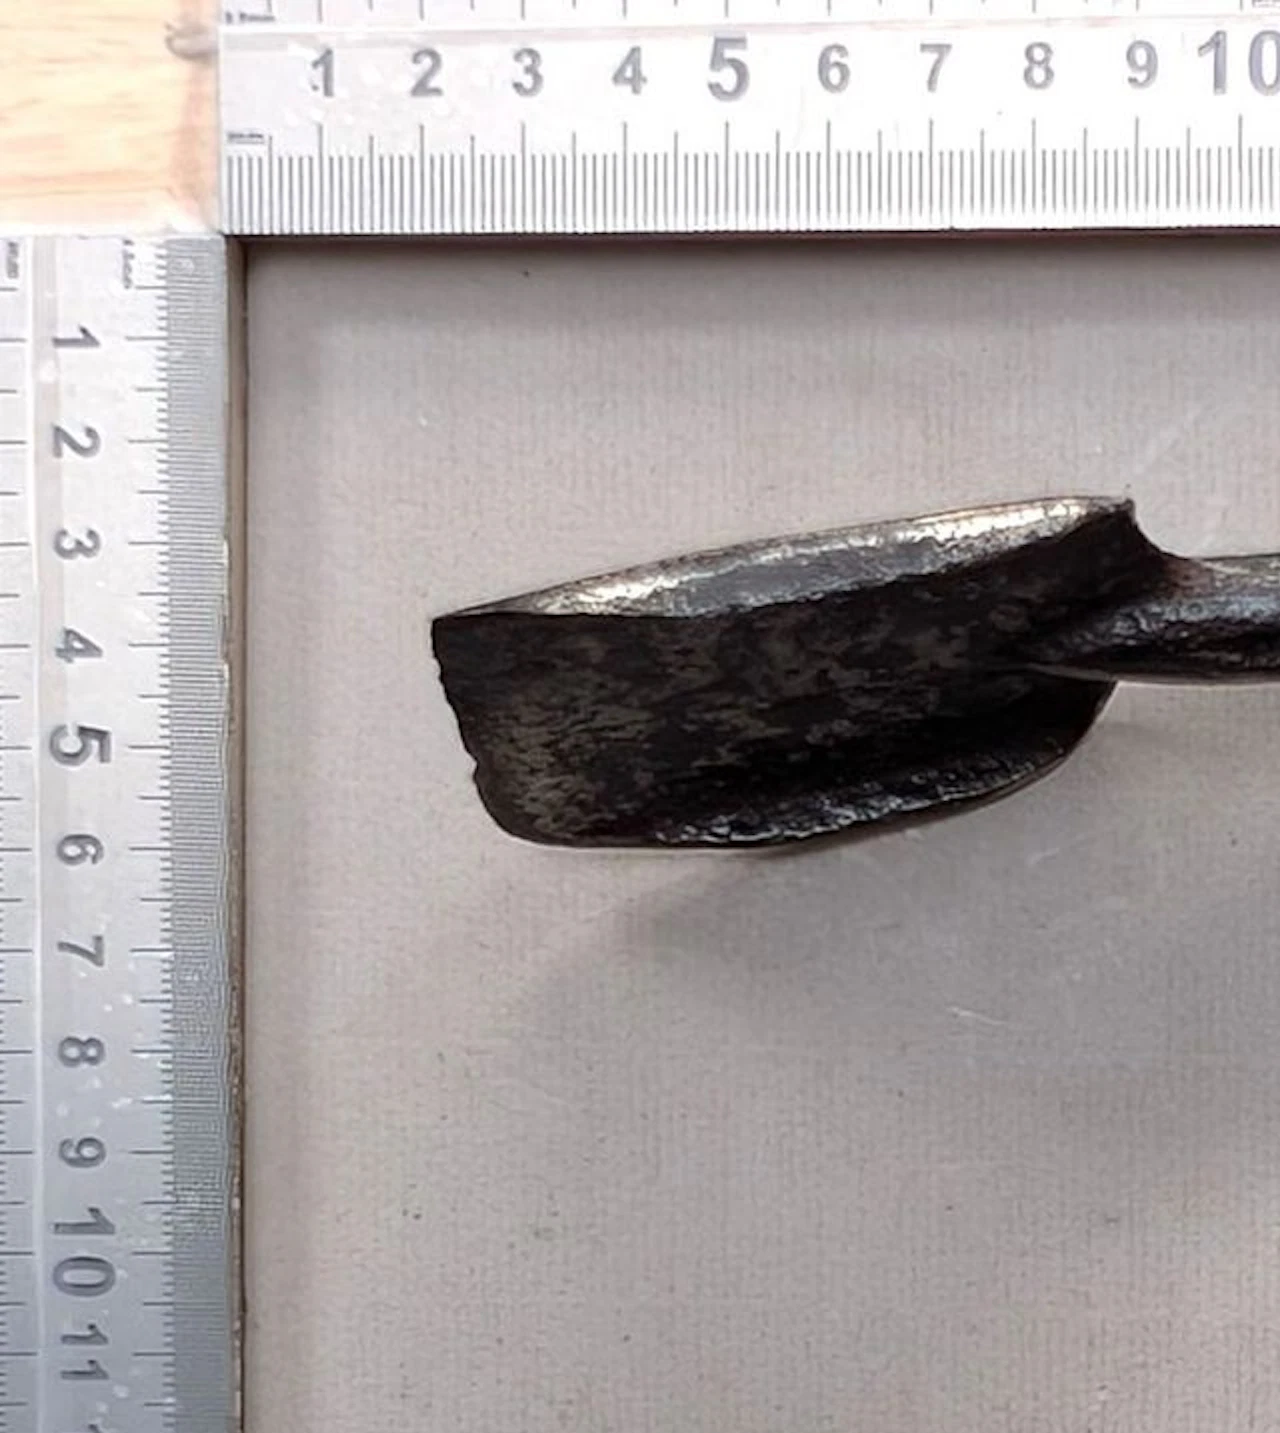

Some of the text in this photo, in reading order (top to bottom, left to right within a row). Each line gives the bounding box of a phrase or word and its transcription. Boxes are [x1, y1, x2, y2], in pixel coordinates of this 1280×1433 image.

[311, 47, 335, 98] 1
[410, 48, 443, 97] 2
[512, 48, 543, 97] 3
[612, 46, 647, 95] 4
[706, 36, 750, 102] 5
[818, 44, 850, 92] 6
[919, 43, 952, 91] 7
[1023, 41, 1055, 89] 8
[1126, 40, 1158, 88] 9
[52, 326, 100, 348] 1
[52, 426, 100, 458] 2
[54, 529, 100, 560] 3
[55, 628, 102, 662] 4
[49, 723, 111, 766] 5
[57, 834, 103, 866] 6
[57, 935, 104, 967] 7
[57, 1036, 105, 1068] 8
[59, 1136, 106, 1168] 9
[53, 1207, 116, 1297] 10
[60, 1323, 108, 1381] 11
